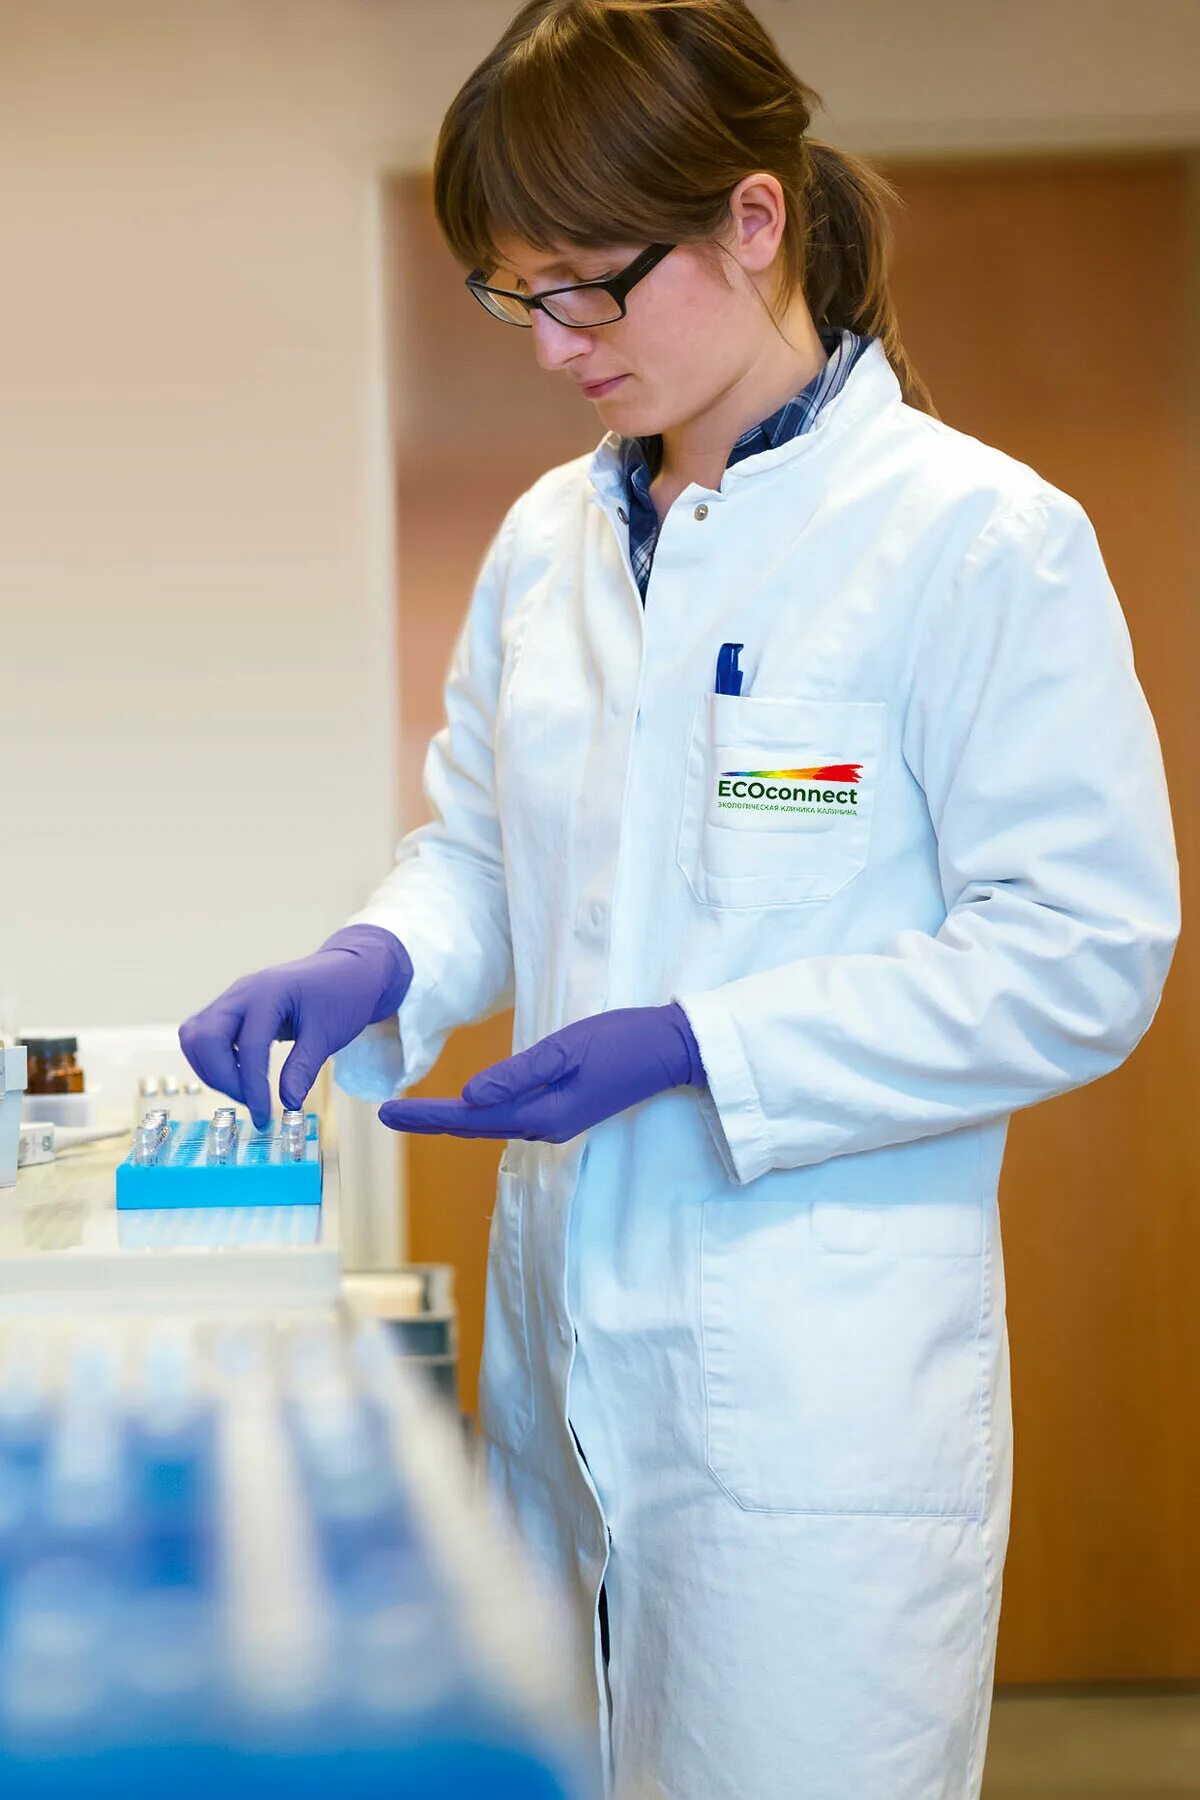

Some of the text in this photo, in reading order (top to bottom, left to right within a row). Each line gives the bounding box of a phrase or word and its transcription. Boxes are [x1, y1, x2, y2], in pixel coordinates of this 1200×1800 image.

[718, 781, 858, 805] ECOconnect
[717, 801, 779, 811] ЭКОЛОГИЧЕСКАЯ
[781, 805, 816, 813] КЛИНИКА
